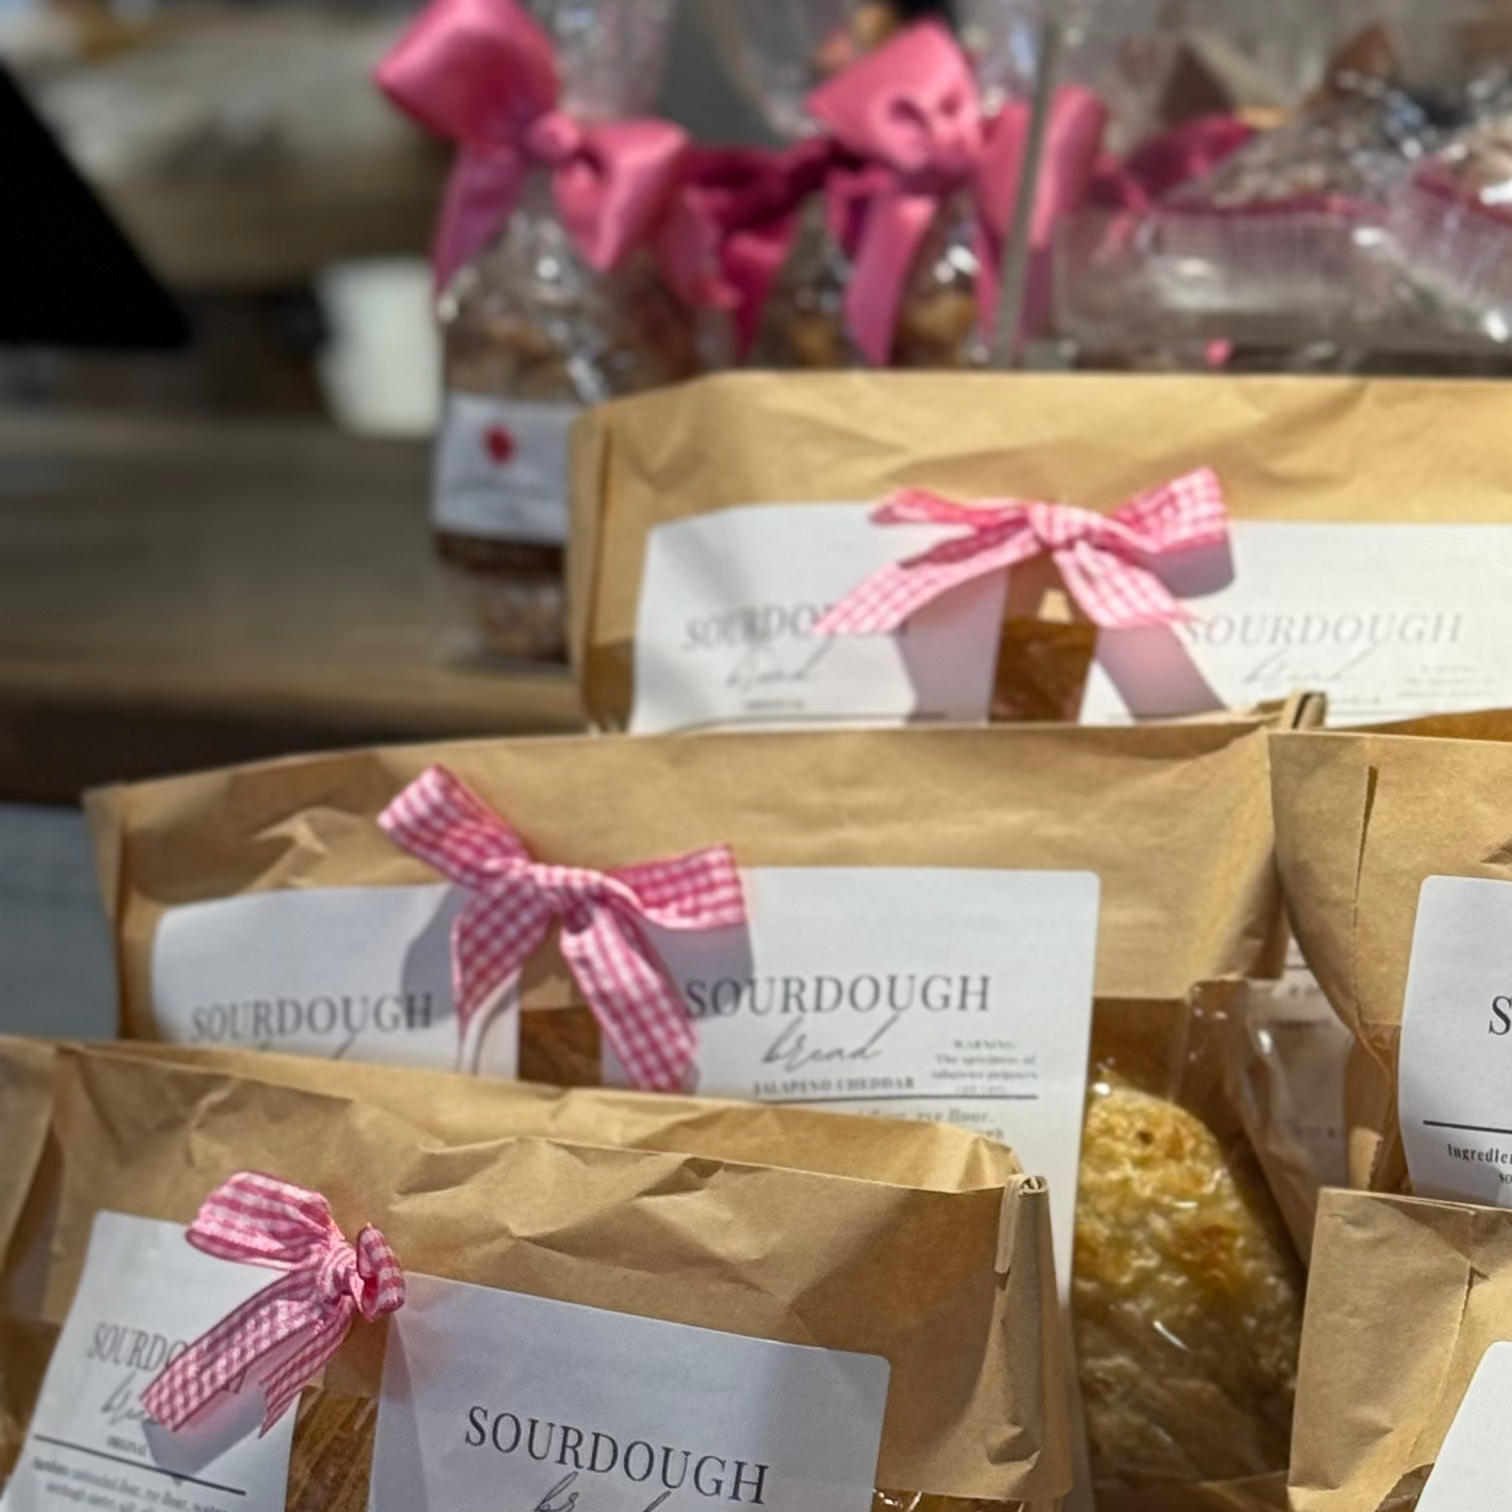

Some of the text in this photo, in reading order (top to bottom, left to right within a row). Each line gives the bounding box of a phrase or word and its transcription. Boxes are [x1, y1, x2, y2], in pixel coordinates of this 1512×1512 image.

[192, 993, 433, 1041] SOURDOUGH
[685, 974, 990, 1018] SOURDOUGH
[464, 1405, 769, 1505] SOURDOUGH
